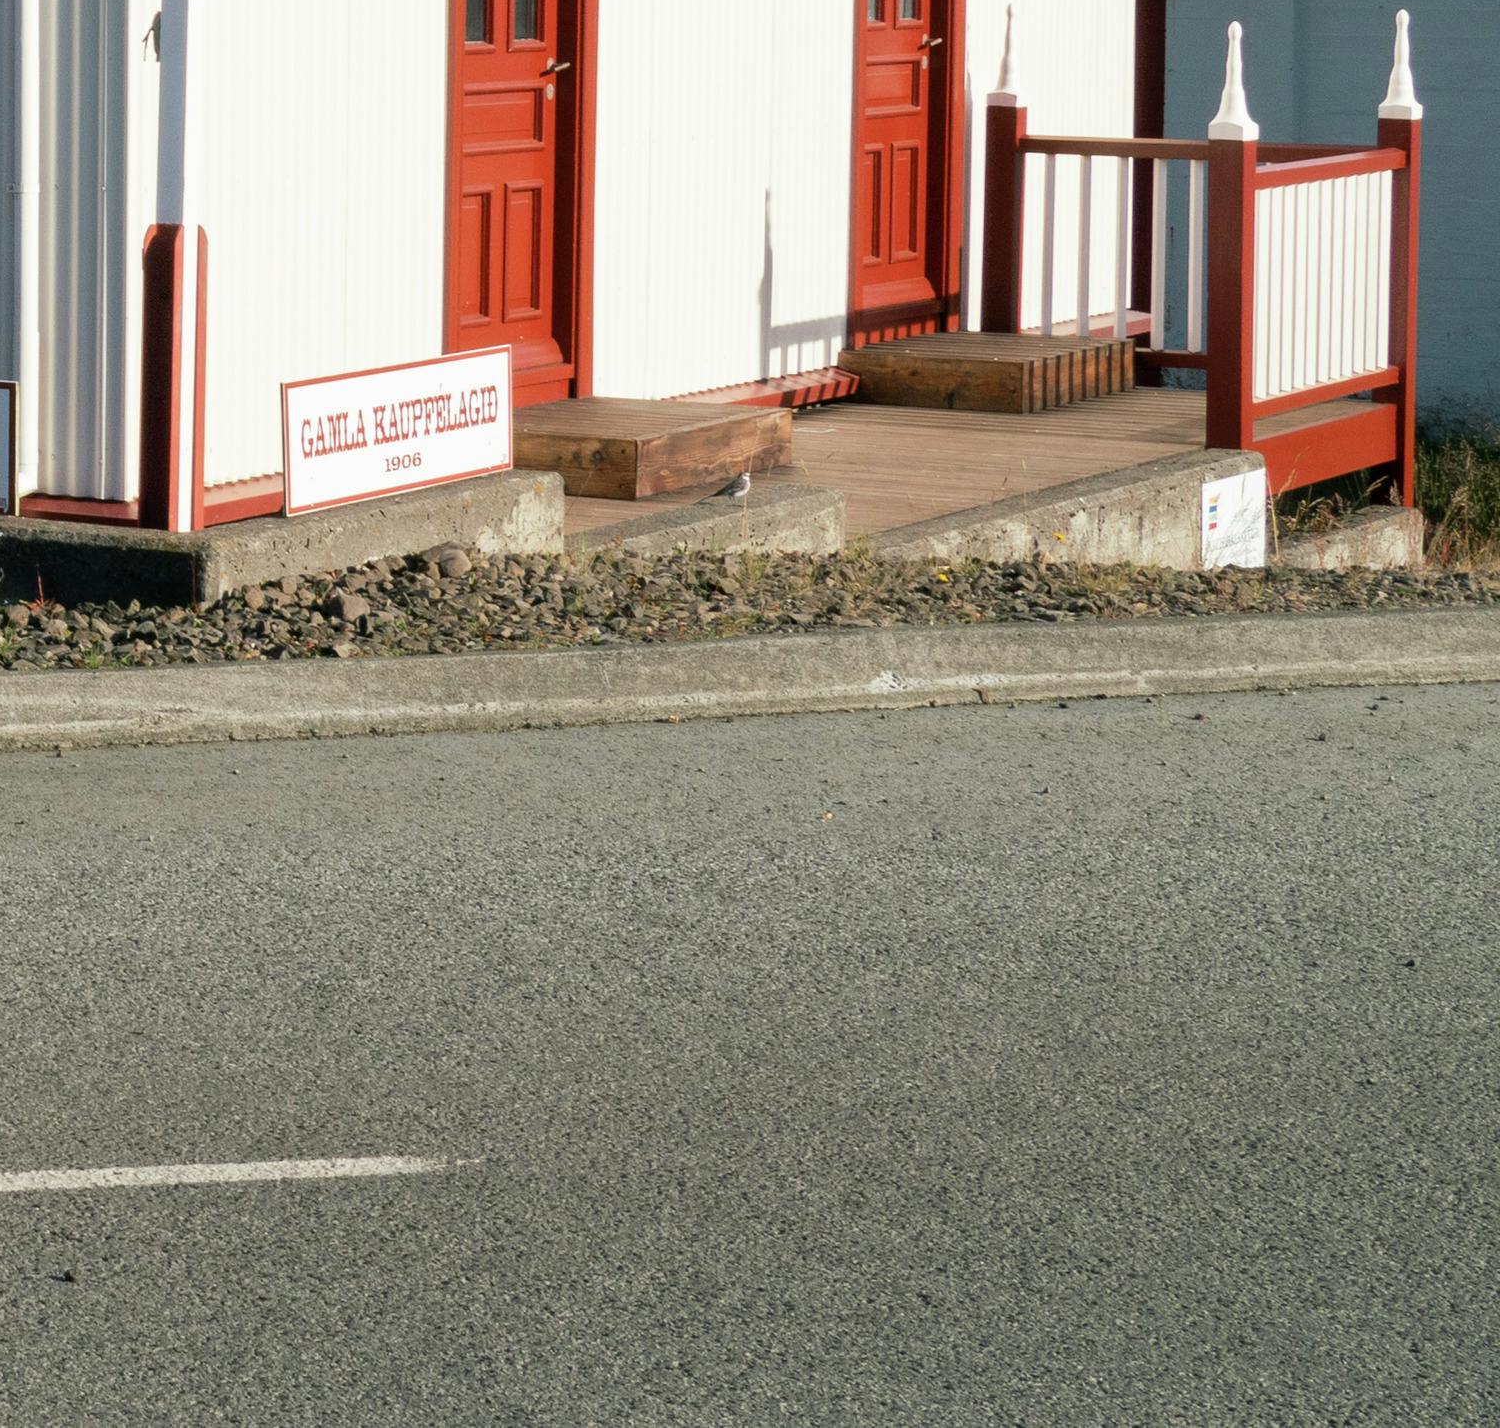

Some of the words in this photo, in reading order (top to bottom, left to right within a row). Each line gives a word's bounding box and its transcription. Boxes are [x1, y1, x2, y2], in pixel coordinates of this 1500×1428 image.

[301, 409, 368, 459] GAMLA
[373, 383, 498, 446] KAUPFÉLAGIÐ
[384, 452, 422, 472] 1906
